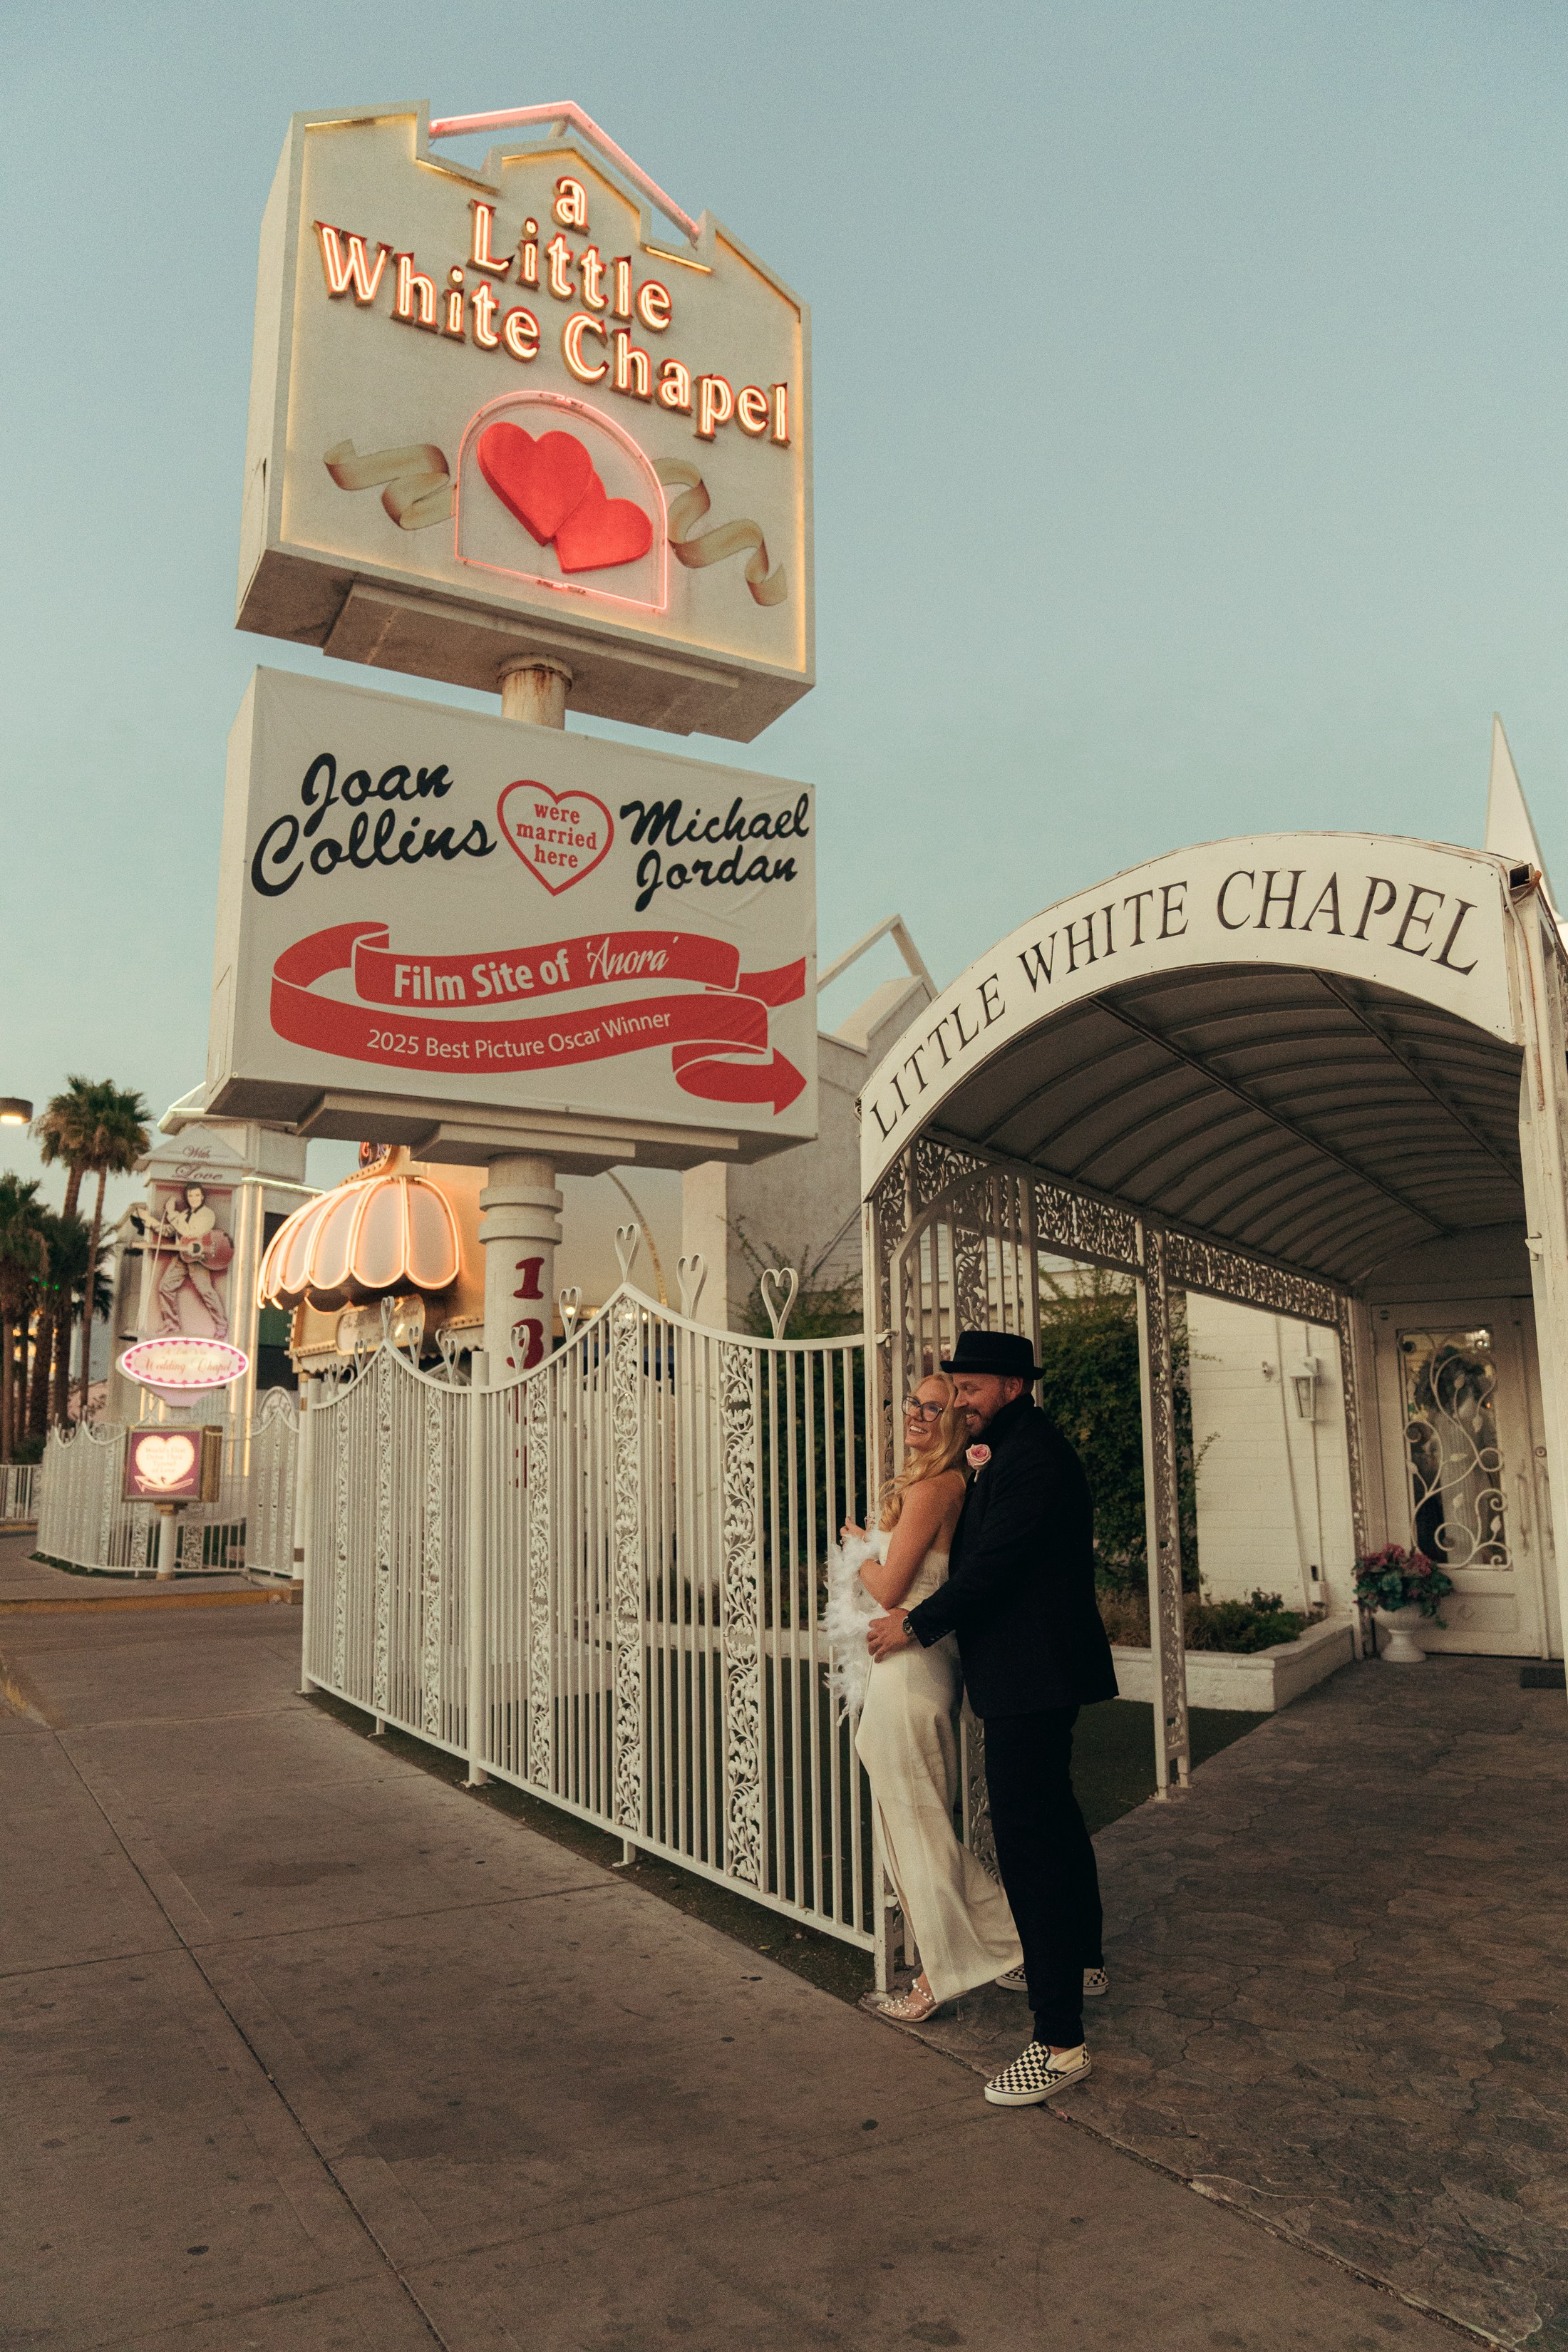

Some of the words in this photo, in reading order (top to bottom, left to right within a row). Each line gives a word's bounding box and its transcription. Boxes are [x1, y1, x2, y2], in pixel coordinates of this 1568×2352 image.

[555, 176, 590, 236] a
[466, 199, 672, 331] Little
[314, 220, 541, 362] White
[559, 311, 792, 448] Chapel
[301, 753, 454, 836] Joan
[534, 803, 580, 825] were
[619, 793, 810, 847] Michael
[251, 808, 497, 897] Collins
[516, 823, 597, 850] married
[534, 844, 579, 868] here
[634, 841, 798, 912] Jordan
[394, 964, 466, 1001] Film
[471, 959, 534, 998] Site
[539, 948, 570, 985] of
[867, 971, 1006, 1143] LITTLE
[1015, 880, 1190, 994] WHITE
[1215, 869, 1480, 976] CHAPEL
[366, 1028, 420, 1056] 2025
[425, 1038, 470, 1059] Best
[475, 1035, 545, 1059] Picture
[547, 1027, 601, 1053] Oscar
[602, 1011, 672, 1040] Winner
[134, 1354, 186, 1375] Wedding
